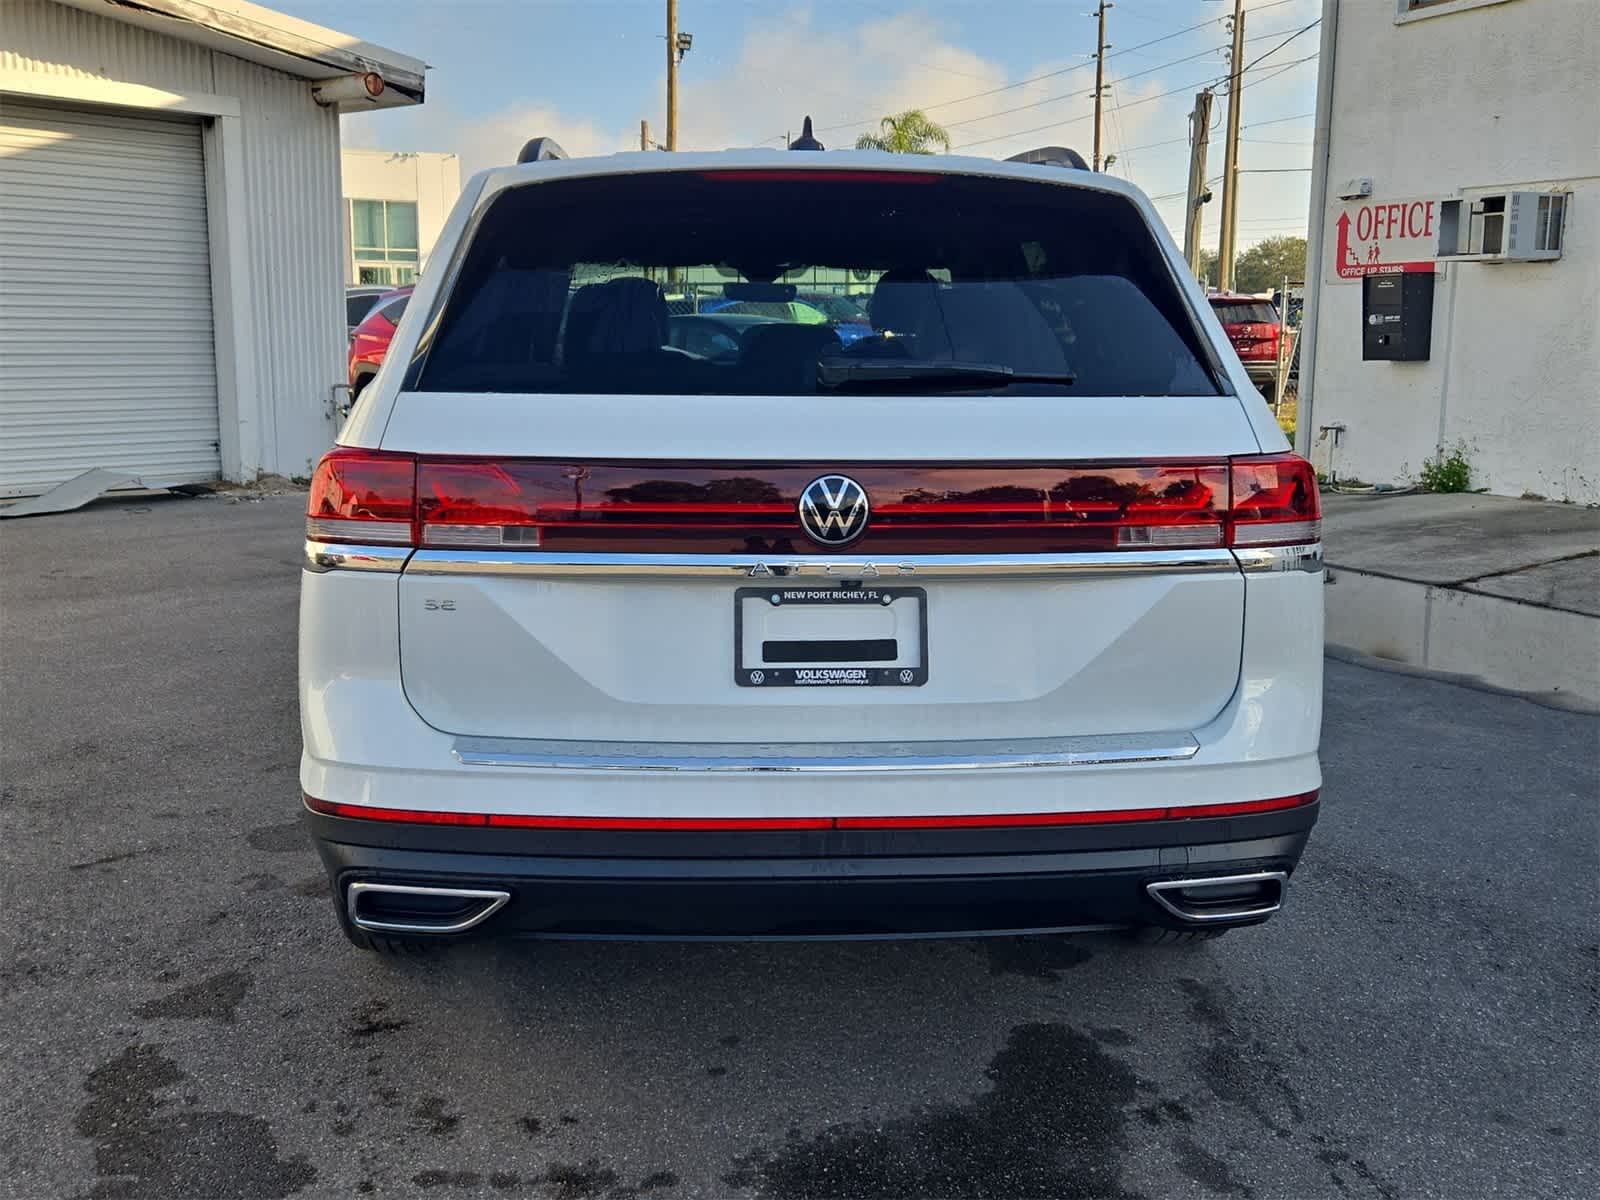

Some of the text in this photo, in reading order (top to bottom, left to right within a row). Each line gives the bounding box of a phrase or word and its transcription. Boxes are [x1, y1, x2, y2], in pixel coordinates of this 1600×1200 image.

[1357, 201, 1434, 241] OFFICE
[1341, 267, 1365, 276] OFFICE
[1379, 265, 1404, 273] STAIRS
[748, 560, 917, 576] ATLAS
[784, 591, 879, 600] NEW PORT RICHEY, FL
[423, 599, 457, 611] SE
[795, 669, 866, 679] VOLKSWAGEN
